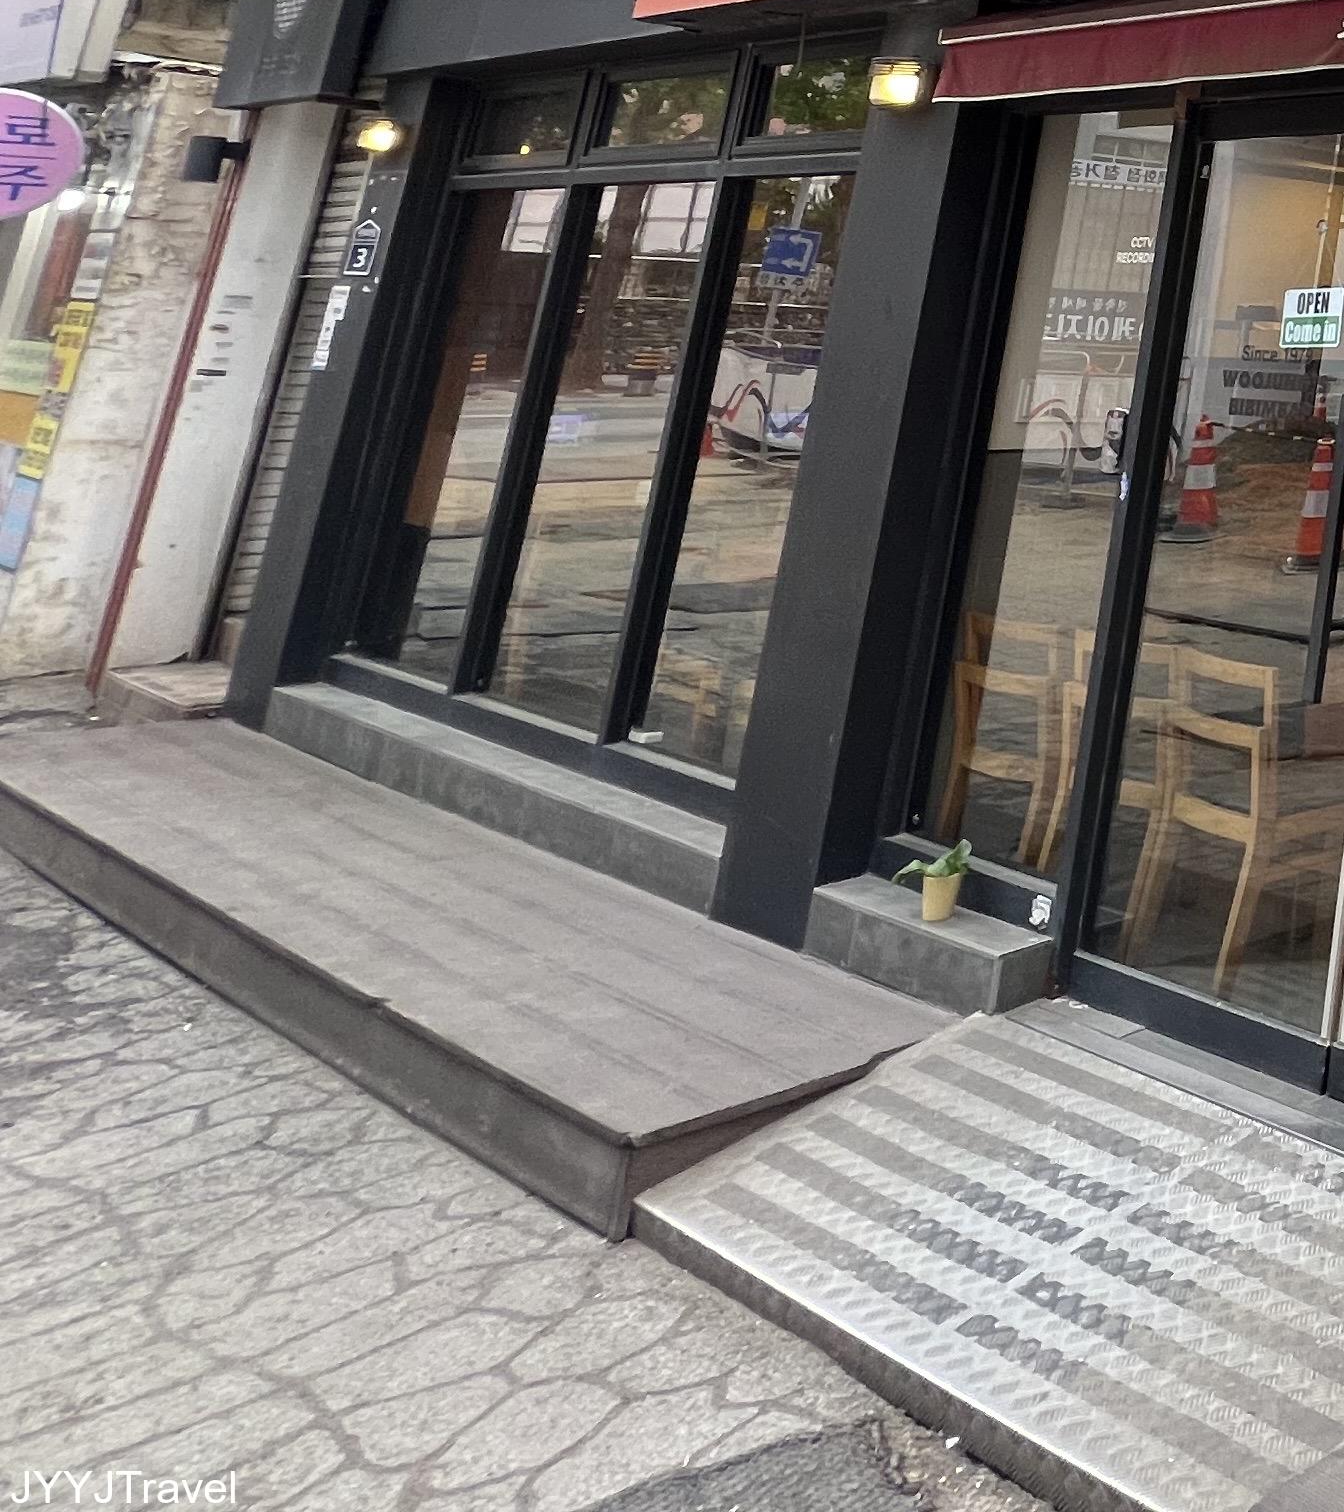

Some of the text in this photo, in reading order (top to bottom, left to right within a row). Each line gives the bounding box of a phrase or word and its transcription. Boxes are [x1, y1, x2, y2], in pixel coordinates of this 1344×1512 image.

[1130, 236, 1156, 248] CCTV
[352, 247, 368, 268] 3
[1297, 291, 1331, 314] OPEN
[1284, 319, 1337, 342] Come in
